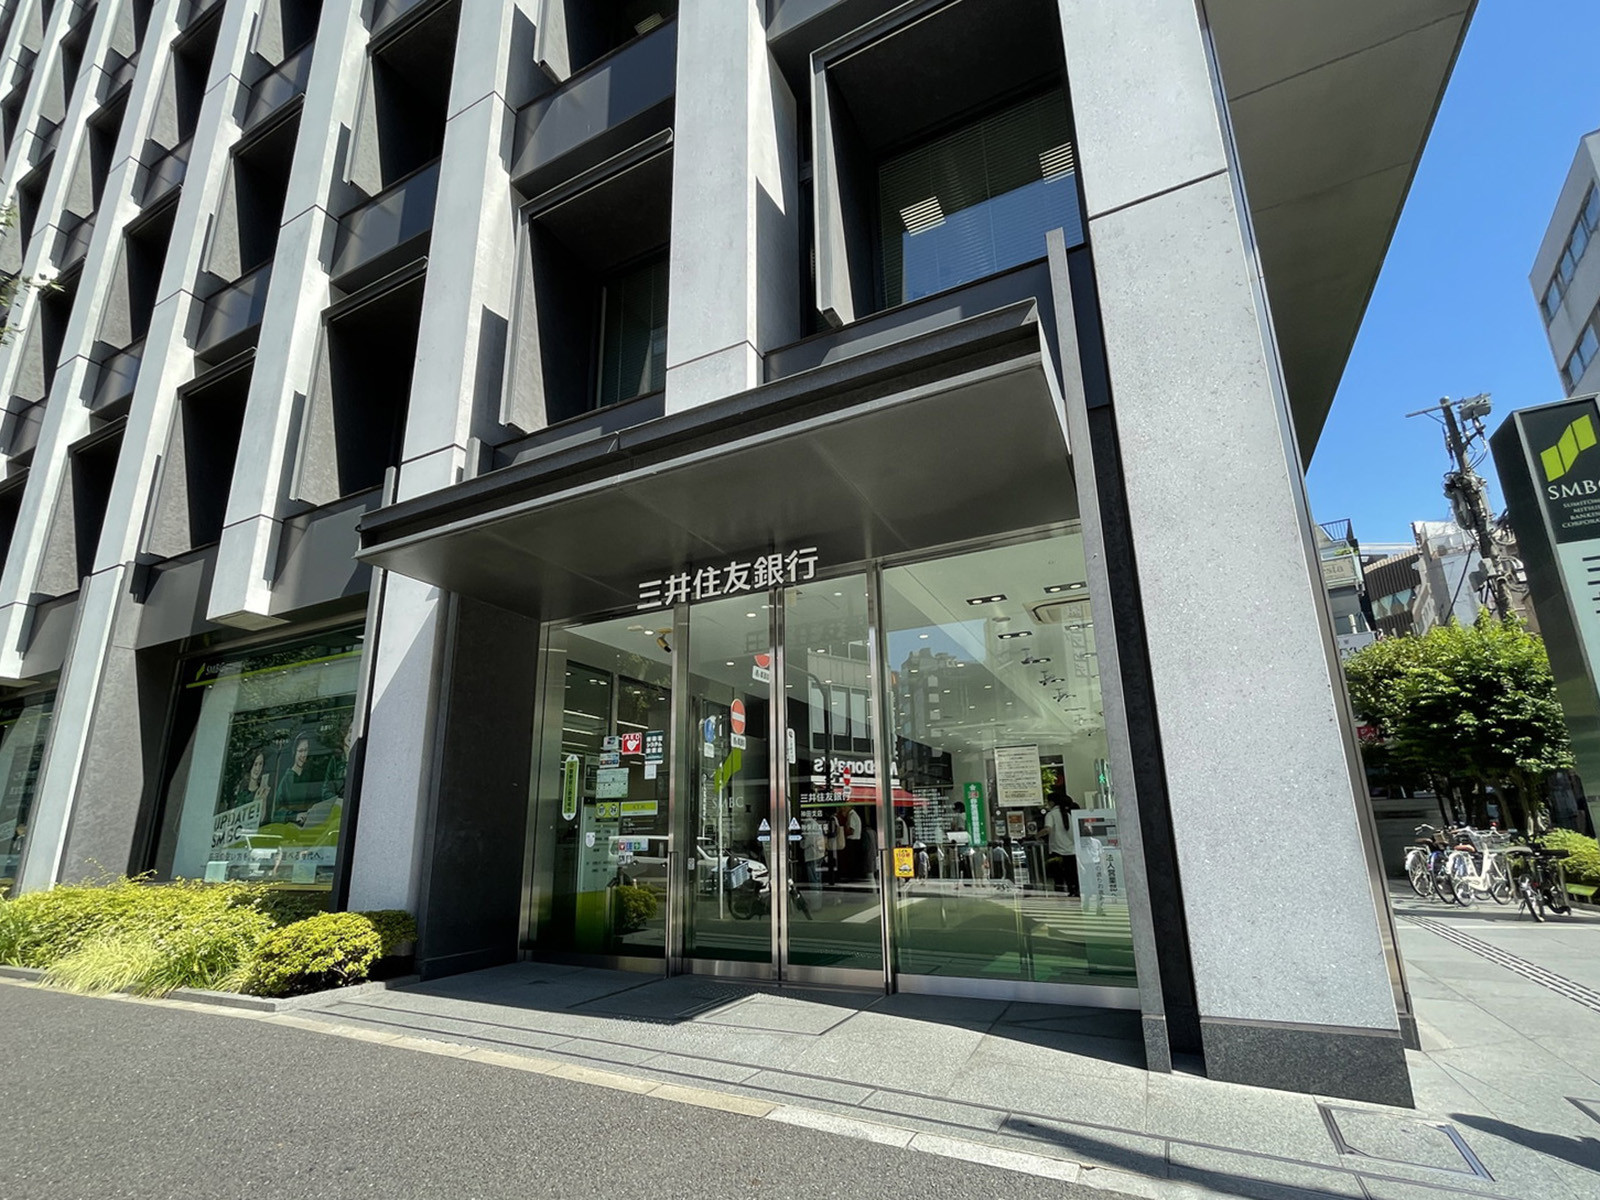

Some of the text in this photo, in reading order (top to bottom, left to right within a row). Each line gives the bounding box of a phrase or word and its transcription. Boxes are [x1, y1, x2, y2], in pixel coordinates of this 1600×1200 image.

[1547, 480, 1600, 500] SMB
[637, 546, 819, 610] 三井住友銀行
[625, 733, 641, 741] AED
[800, 791, 850, 803] 三井住友銀行
[213, 803, 261, 832] UPDATE!
[210, 825, 243, 848] SMBC
